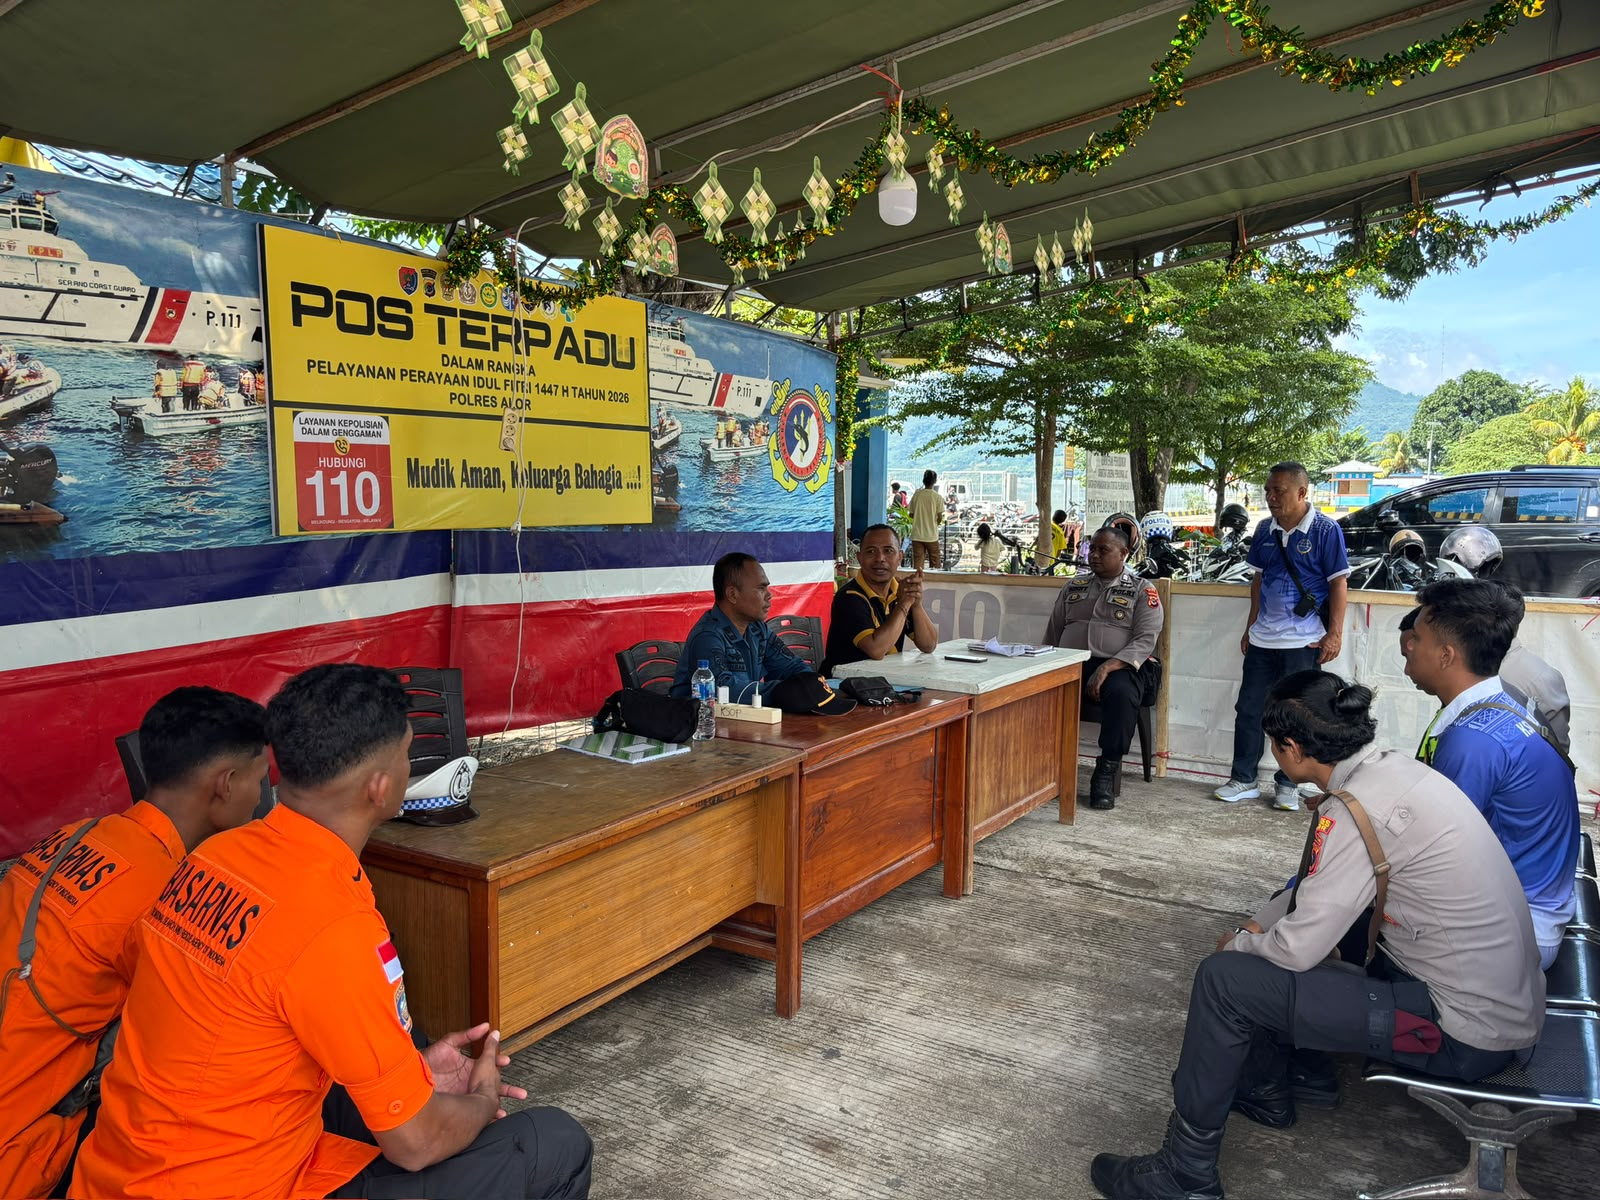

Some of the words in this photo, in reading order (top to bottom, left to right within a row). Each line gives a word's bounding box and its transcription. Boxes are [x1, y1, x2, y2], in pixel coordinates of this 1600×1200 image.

[28, 245, 63, 258] KPLP
[206, 311, 241, 329] P.111
[291, 281, 414, 341] POS
[424, 303, 635, 370] TERPADU
[442, 353, 484, 371] DALAM
[307, 359, 396, 380] PELAYANAN
[400, 368, 469, 387] PERAYAAN
[473, 376, 501, 390] IDUL
[504, 379, 532, 394] FITRI
[535, 382, 559, 397] 1447
[562, 386, 569, 398] H
[572, 386, 606, 402] TAHUN
[608, 390, 630, 404] 2026
[450, 392, 498, 408] POLRES
[299, 417, 336, 427] LAYANAN
[338, 419, 384, 430] KEPOLISIAN
[301, 427, 330, 437] DALAM
[331, 428, 382, 438] GENGGAMAN
[318, 457, 367, 468] HUBUNGI
[406, 458, 456, 489] Mudik
[460, 459, 506, 493] Aman,
[511, 460, 571, 495] Keluarga
[575, 462, 623, 495] Bahagia
[306, 470, 381, 517] 110
